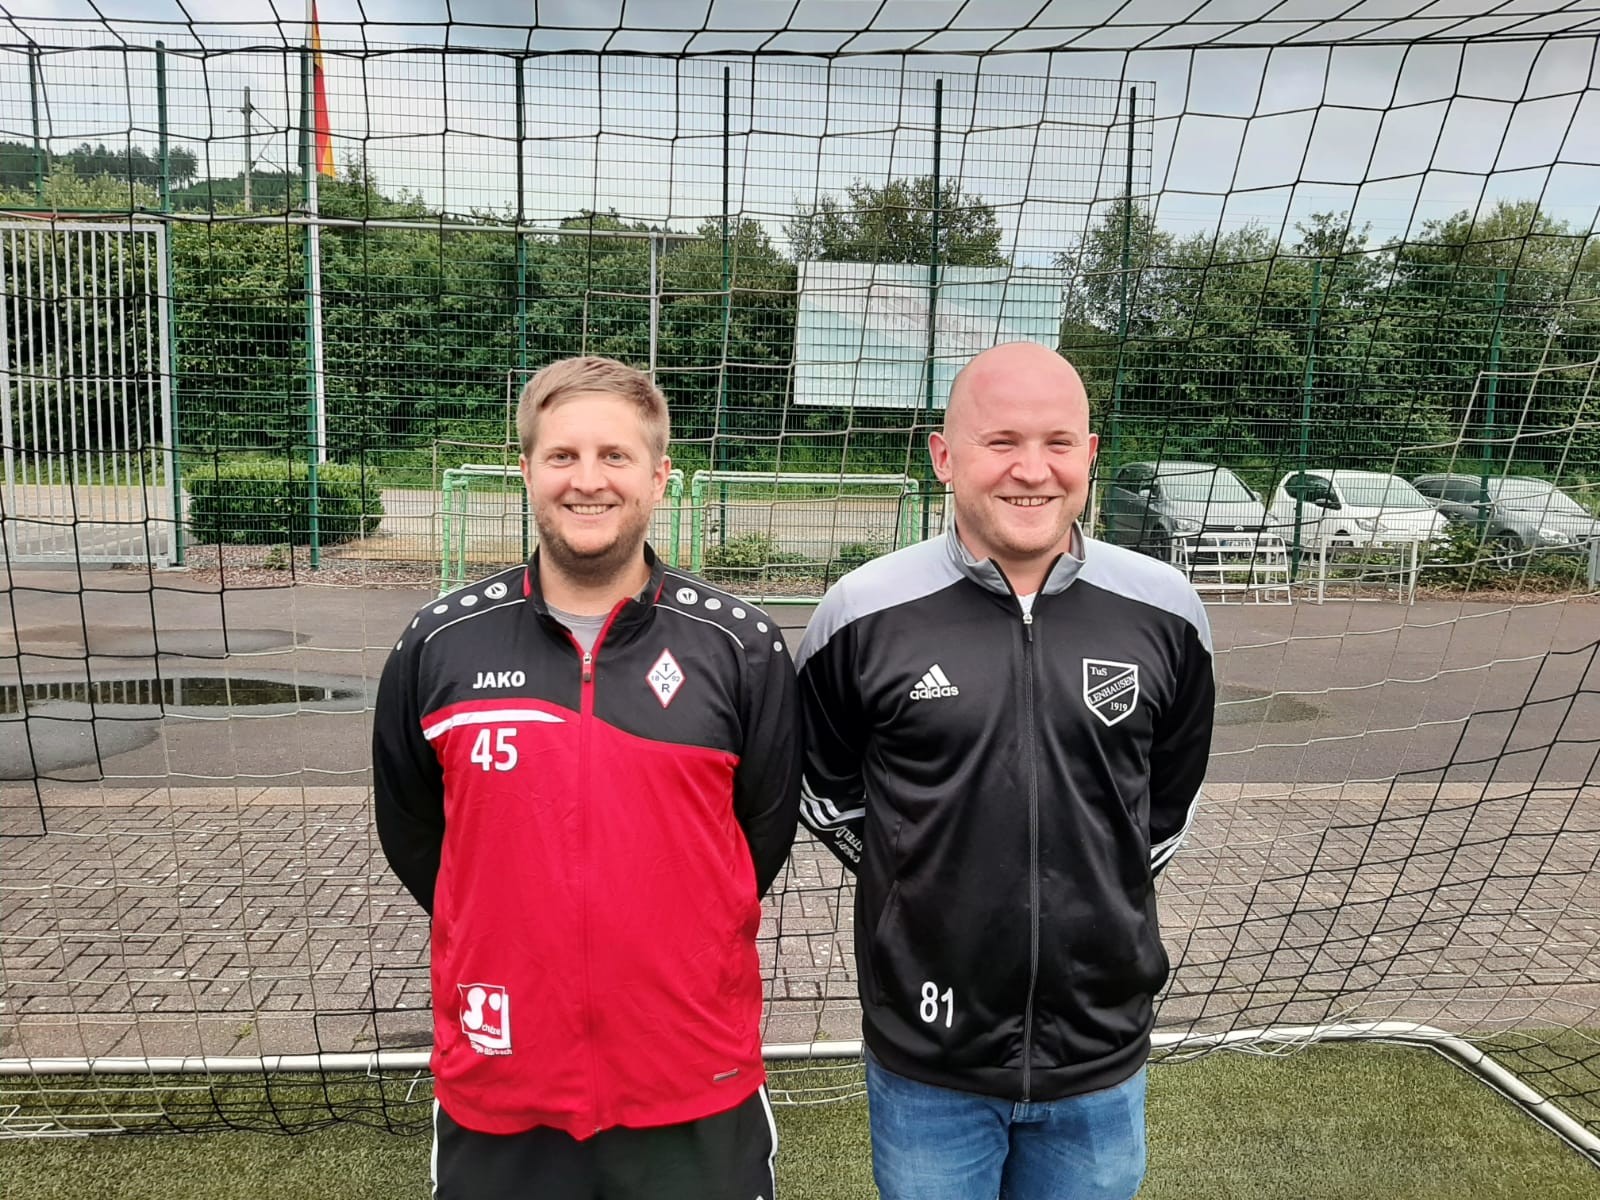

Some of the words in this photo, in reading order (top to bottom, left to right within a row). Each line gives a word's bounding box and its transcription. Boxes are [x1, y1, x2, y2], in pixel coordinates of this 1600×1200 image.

[472, 670, 526, 689] JAKO
[1089, 666, 1108, 677] TuS
[909, 686, 960, 700] adidas
[1088, 674, 1135, 704] LENHAUSEN
[1110, 701, 1128, 712] 1919
[470, 727, 519, 771] 45
[919, 981, 954, 1028] 81
